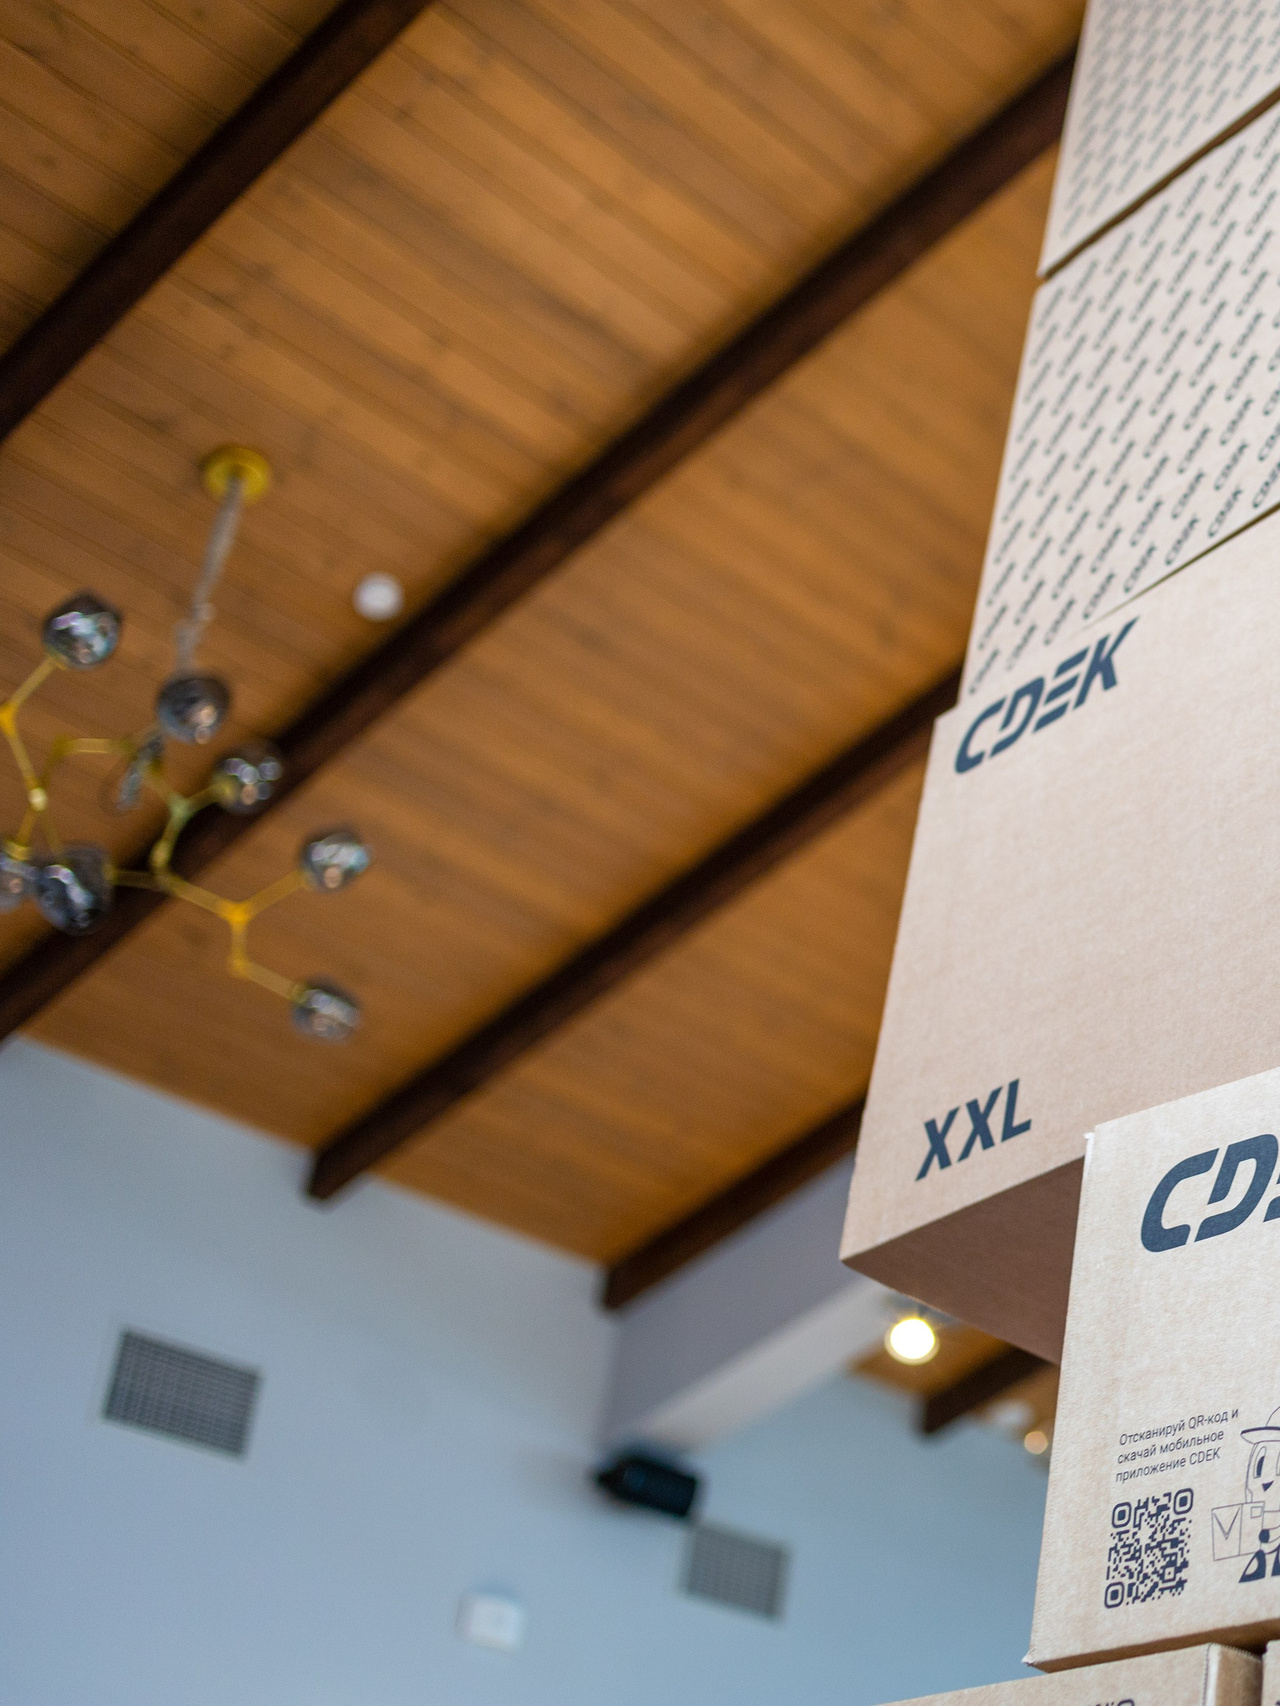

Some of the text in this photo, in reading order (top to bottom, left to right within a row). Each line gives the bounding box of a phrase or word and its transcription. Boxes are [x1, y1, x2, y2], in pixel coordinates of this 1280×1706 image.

[955, 616, 1138, 774] CDEK
[915, 1078, 1031, 1181] XXL
[1119, 1408, 1239, 1446] Отсканируй QR-код и
[1115, 1447, 1222, 1484] приложение CDEK
[1117, 1430, 1225, 1465] скачай мобильное
